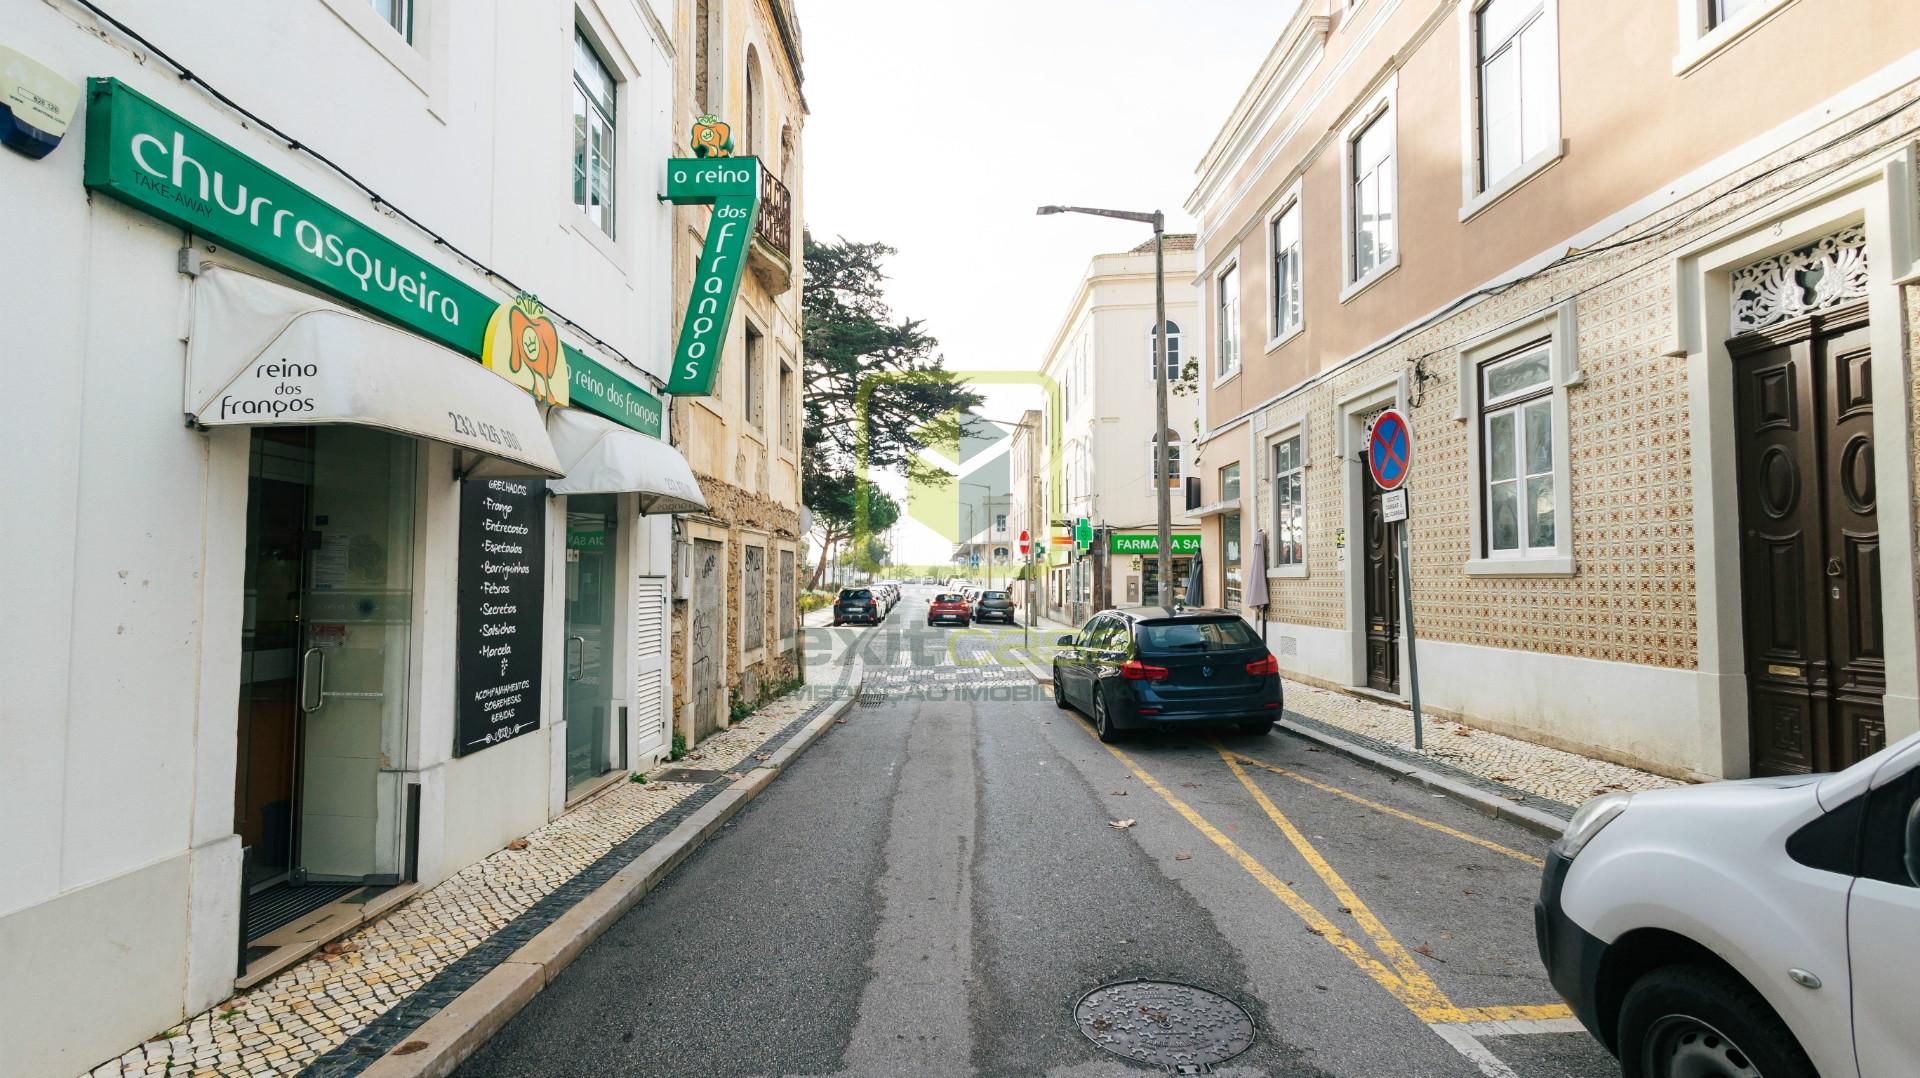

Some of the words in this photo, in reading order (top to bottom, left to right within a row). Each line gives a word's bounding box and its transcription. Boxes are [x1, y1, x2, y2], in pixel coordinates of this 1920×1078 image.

[674, 170, 687, 183] o
[695, 165, 750, 183] reino
[132, 169, 213, 218] TAKE-AWAY
[717, 204, 747, 218] dos
[130, 131, 459, 326] churrasqueira
[256, 357, 318, 378] reino
[275, 381, 302, 395] dos
[575, 369, 604, 397] reino
[606, 383, 624, 408] dos
[448, 411, 477, 438] 233
[477, 419, 501, 445] 426
[488, 480, 527, 496] GRELHADOS
[486, 497, 513, 520] Frango
[485, 518, 529, 535] Entrecosto
[485, 539, 523, 555] Espetadas
[1117, 537, 1180, 550] FARMÁA
[484, 560, 530, 581] Barriguinhas
[484, 581, 510, 594] Febras
[482, 602, 517, 616] Secretos
[482, 621, 517, 637] Salsichas
[482, 643, 512, 658] Morcela
[474, 680, 530, 701] ACOMPANHAMENTOS
[483, 694, 522, 712] SOBREMESAS
[491, 708, 516, 723] BEBIDAS
